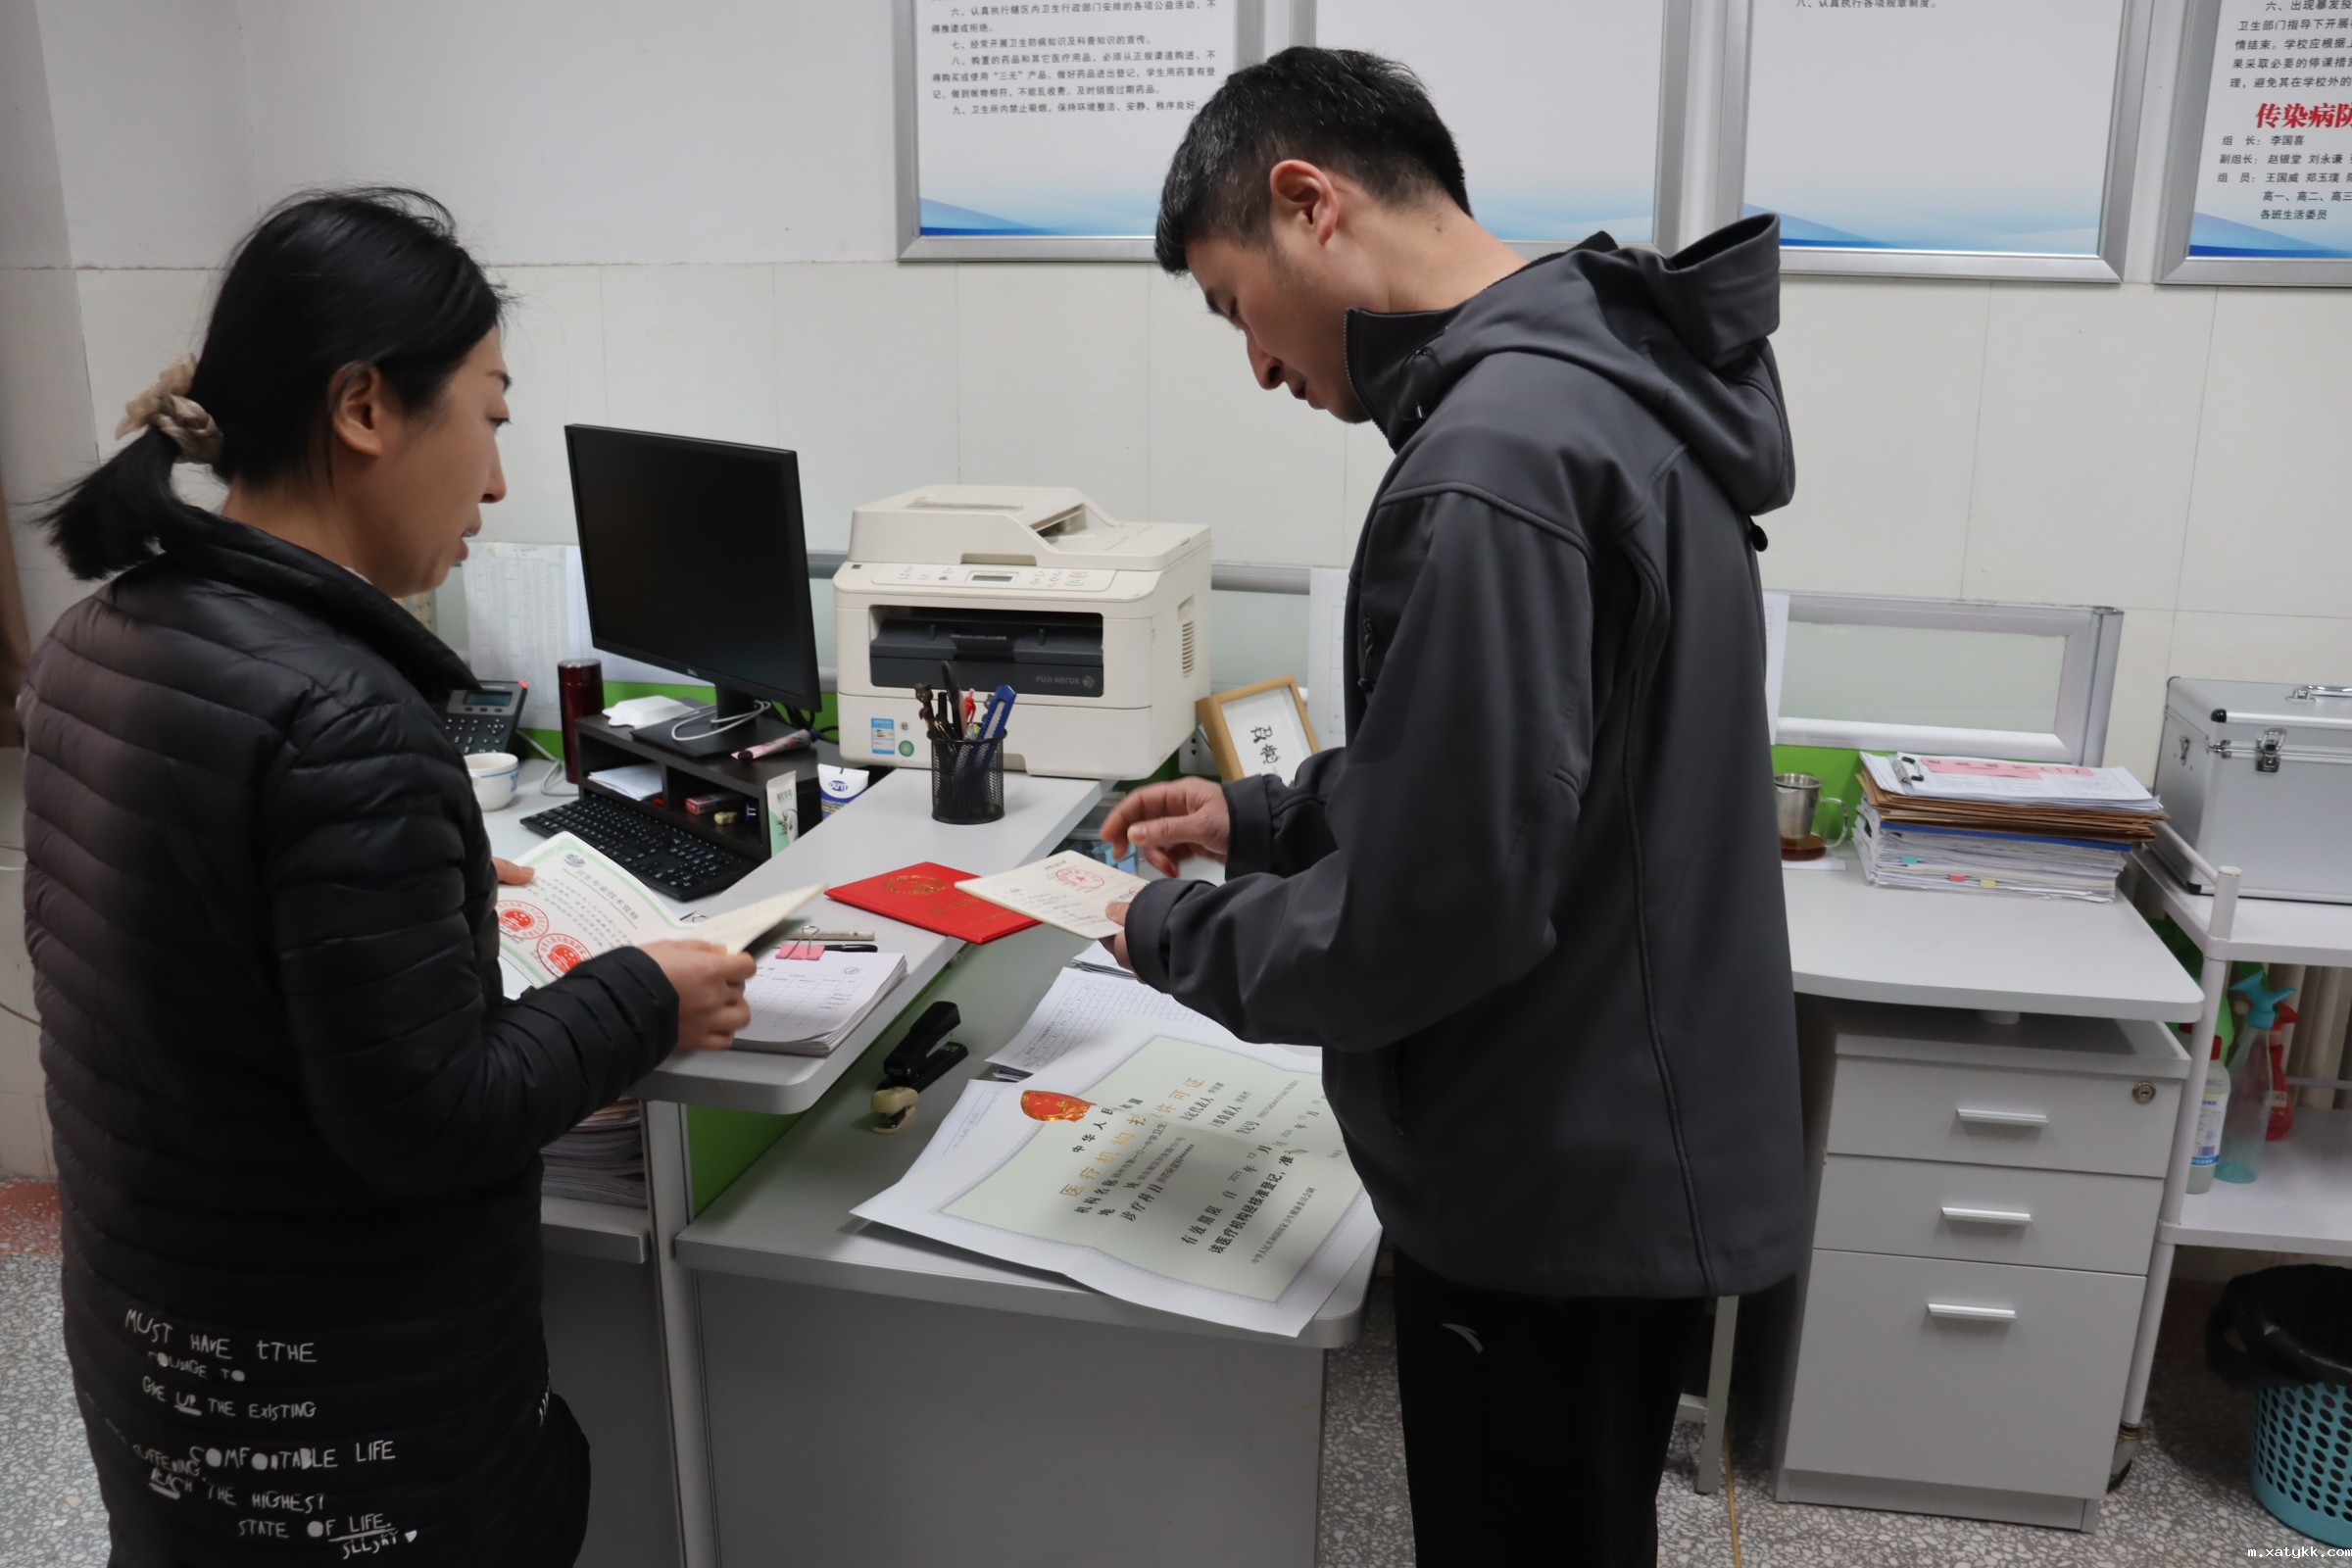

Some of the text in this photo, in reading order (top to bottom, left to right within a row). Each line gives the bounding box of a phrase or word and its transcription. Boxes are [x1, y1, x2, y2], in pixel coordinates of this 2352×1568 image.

[2237, 18, 2352, 31] 卫生部门指导下开展
[2255, 102, 2352, 128] 传染病防
[124, 1308, 173, 1344] MUST
[190, 1333, 233, 1360] HAVE
[208, 1397, 236, 1417] THE
[355, 1439, 396, 1462] LIFE
[251, 1490, 324, 1514] HIGHEST
[238, 1518, 290, 1539] STATE
